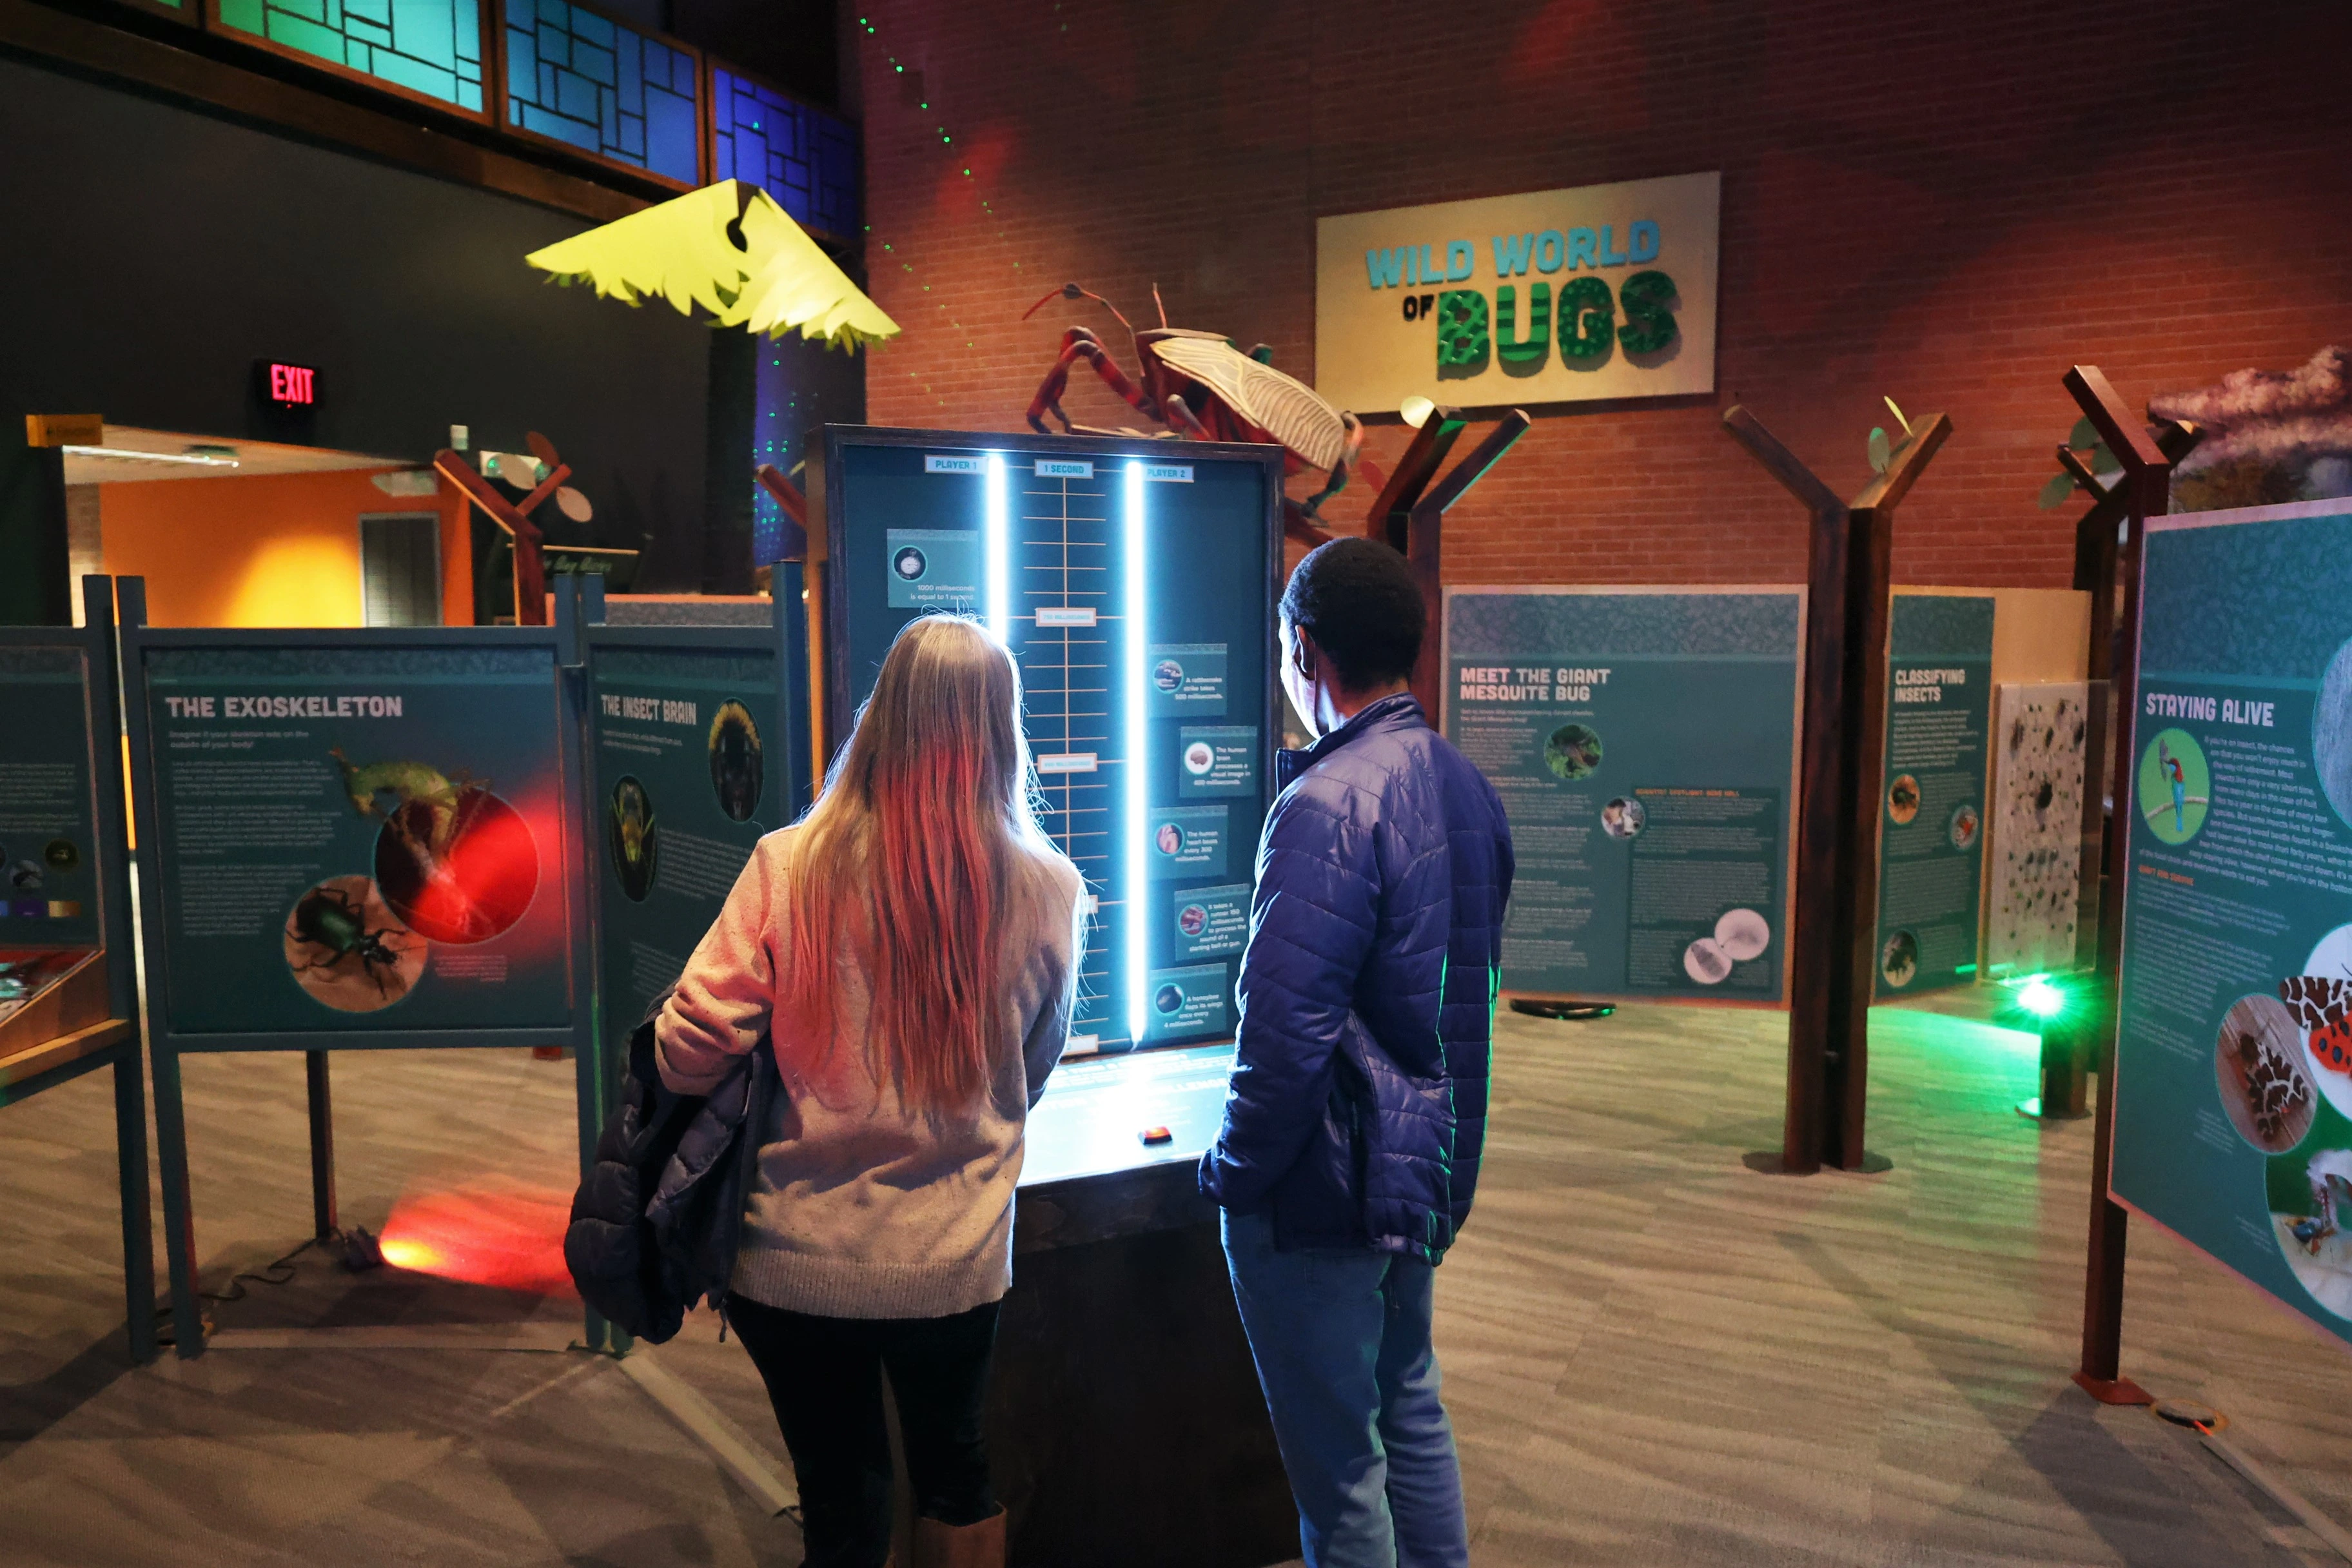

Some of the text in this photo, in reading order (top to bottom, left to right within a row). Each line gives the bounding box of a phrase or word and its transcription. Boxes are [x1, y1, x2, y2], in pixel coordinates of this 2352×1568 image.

[1366, 220, 1660, 289] WILD WORLD
[1402, 270, 1678, 368] OF BUGS
[271, 364, 314, 404] EXIT
[936, 460, 970, 469] PLAYER
[1051, 465, 1084, 474] SECOND
[1460, 667, 1611, 685] MEET THE GIANT
[1896, 669, 1965, 685] CLASSIFYING
[1460, 685, 1591, 701] MESQUITE BUG
[1894, 686, 1941, 702] INSECTS
[164, 696, 402, 718] THE EXOSKELETON
[601, 694, 696, 725] THE INSECT BRAIN
[2146, 692, 2275, 727] STAYING ALIVE
